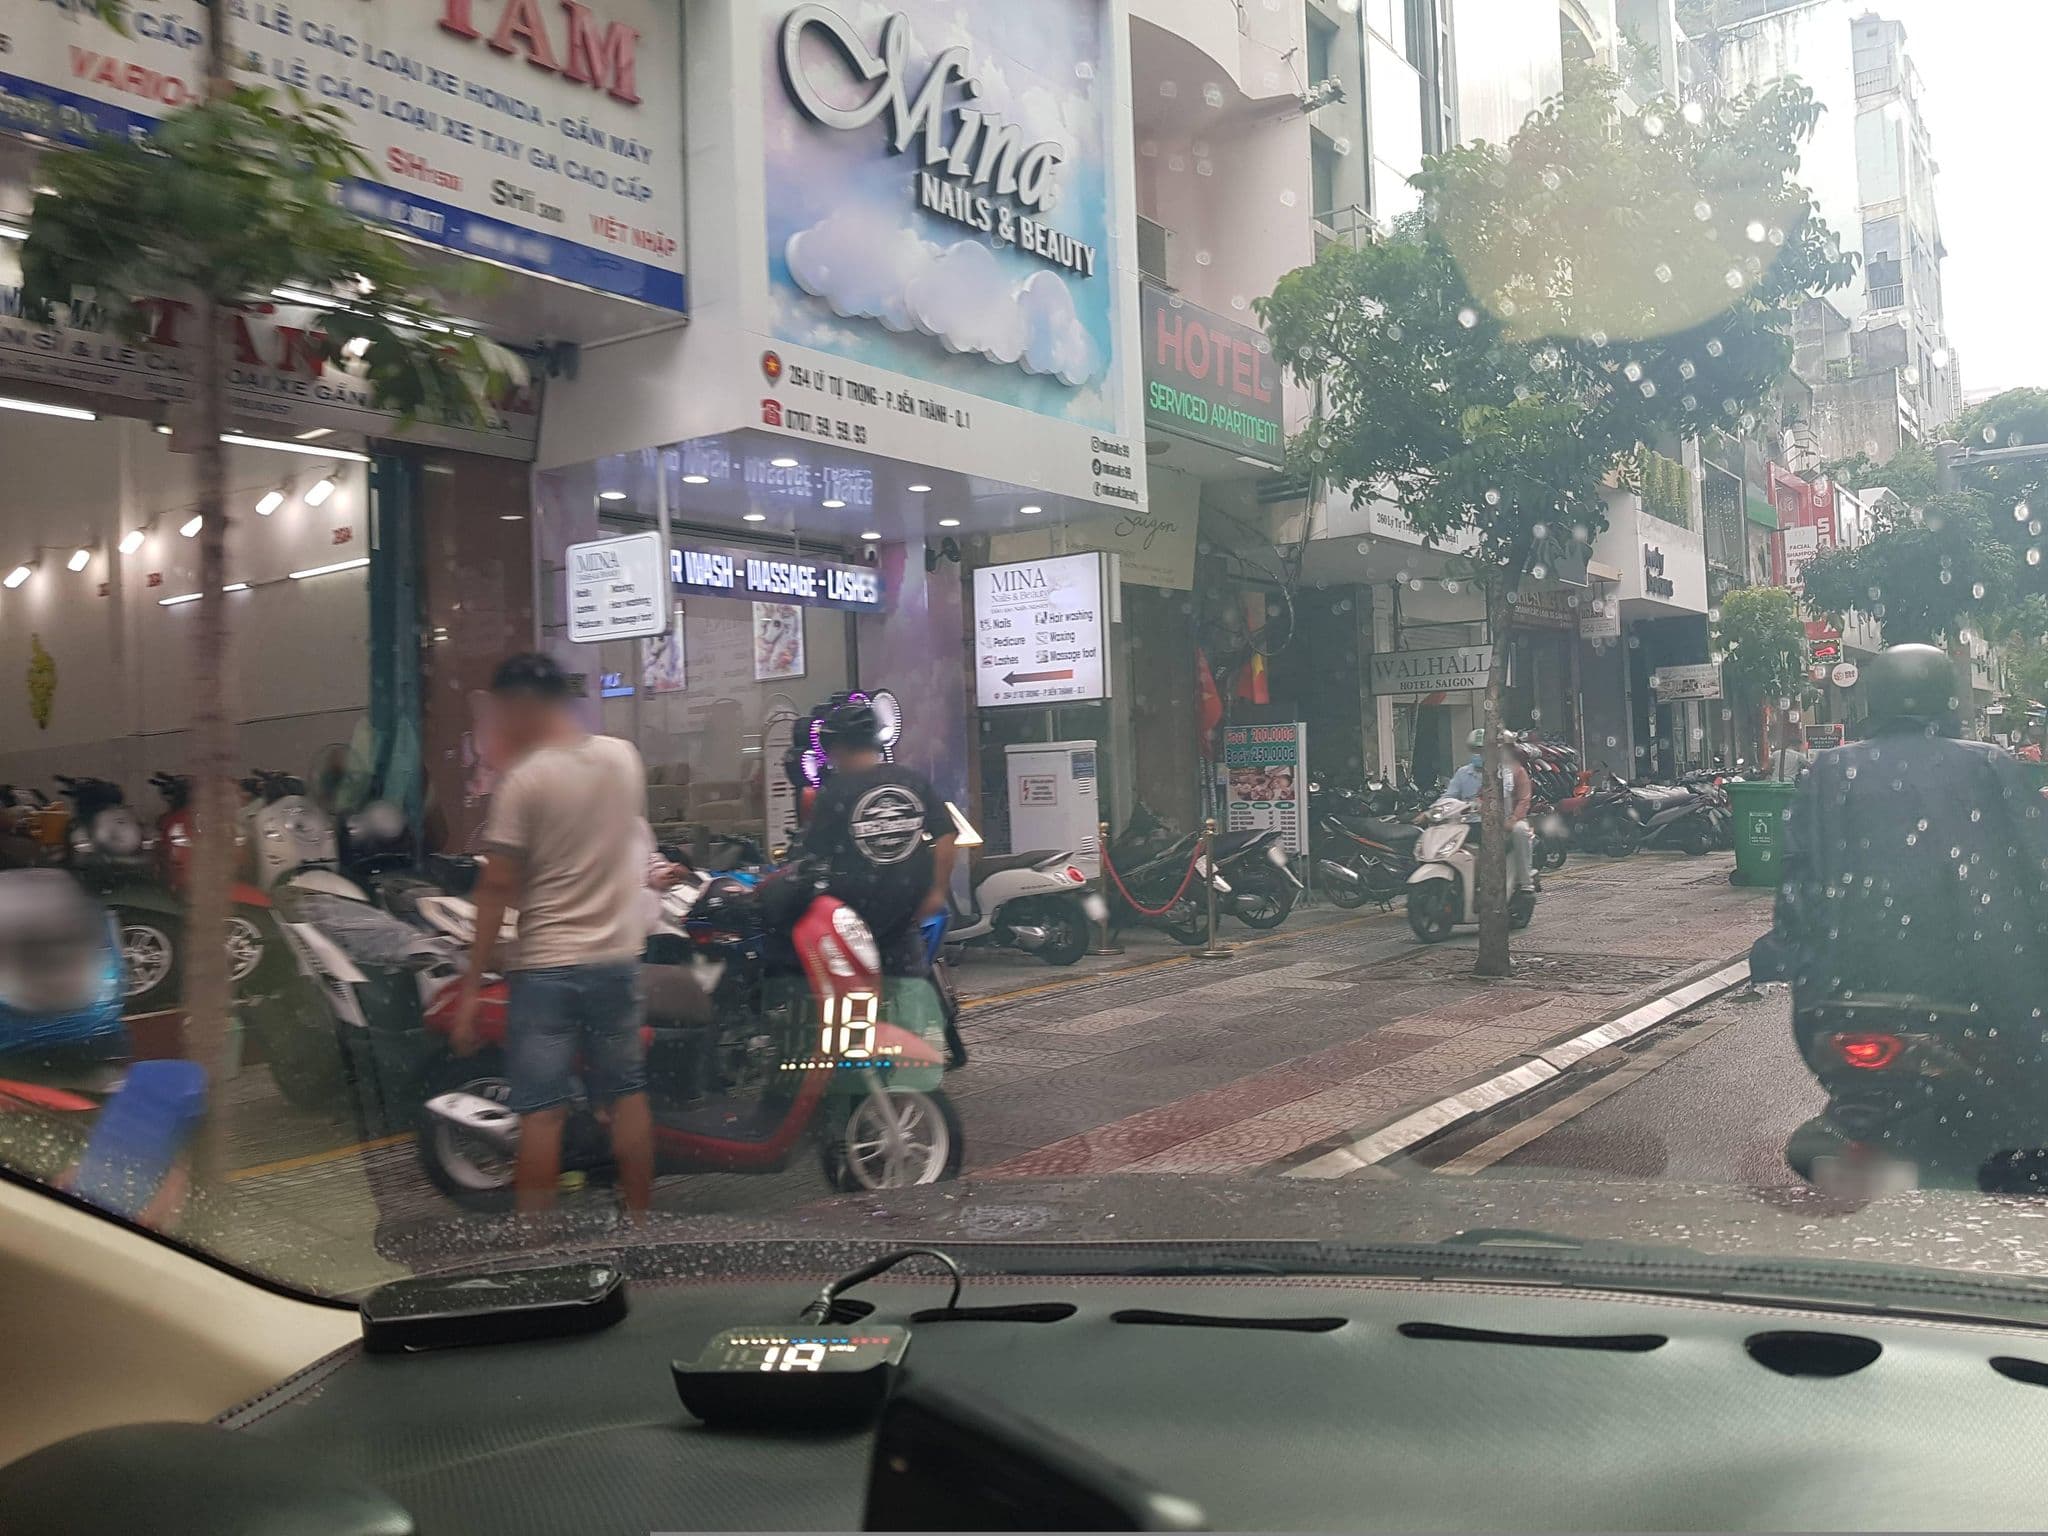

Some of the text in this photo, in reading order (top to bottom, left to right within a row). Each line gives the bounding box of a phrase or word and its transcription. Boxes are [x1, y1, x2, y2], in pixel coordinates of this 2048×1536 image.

[302, 20, 359, 58] CÁC
[425, 64, 460, 95] XE
[463, 80, 546, 127] HONDA
[316, 73, 375, 110] CÁC
[440, 114, 475, 145] XE
[478, 127, 525, 160] TAY
[527, 146, 561, 175] GA
[563, 159, 609, 190] CAO
[778, 1, 1066, 213] Mina
[917, 171, 1097, 278] NAILS & BEAUTY
[1156, 306, 1272, 404] HOTEL
[1149, 381, 1209, 424] SERVICED
[684, 550, 735, 589] WASH
[746, 558, 818, 598] MASSAGE
[826, 568, 879, 605] LASHES
[991, 567, 1048, 594] MINA
[993, 610, 1094, 630] Nails Hair washing
[993, 631, 1076, 648] Pedicure Waxing
[1049, 650, 1082, 662] Massage
[1400, 676, 1476, 691] HOTEL SAIGON
[821, 991, 878, 1058] 18
